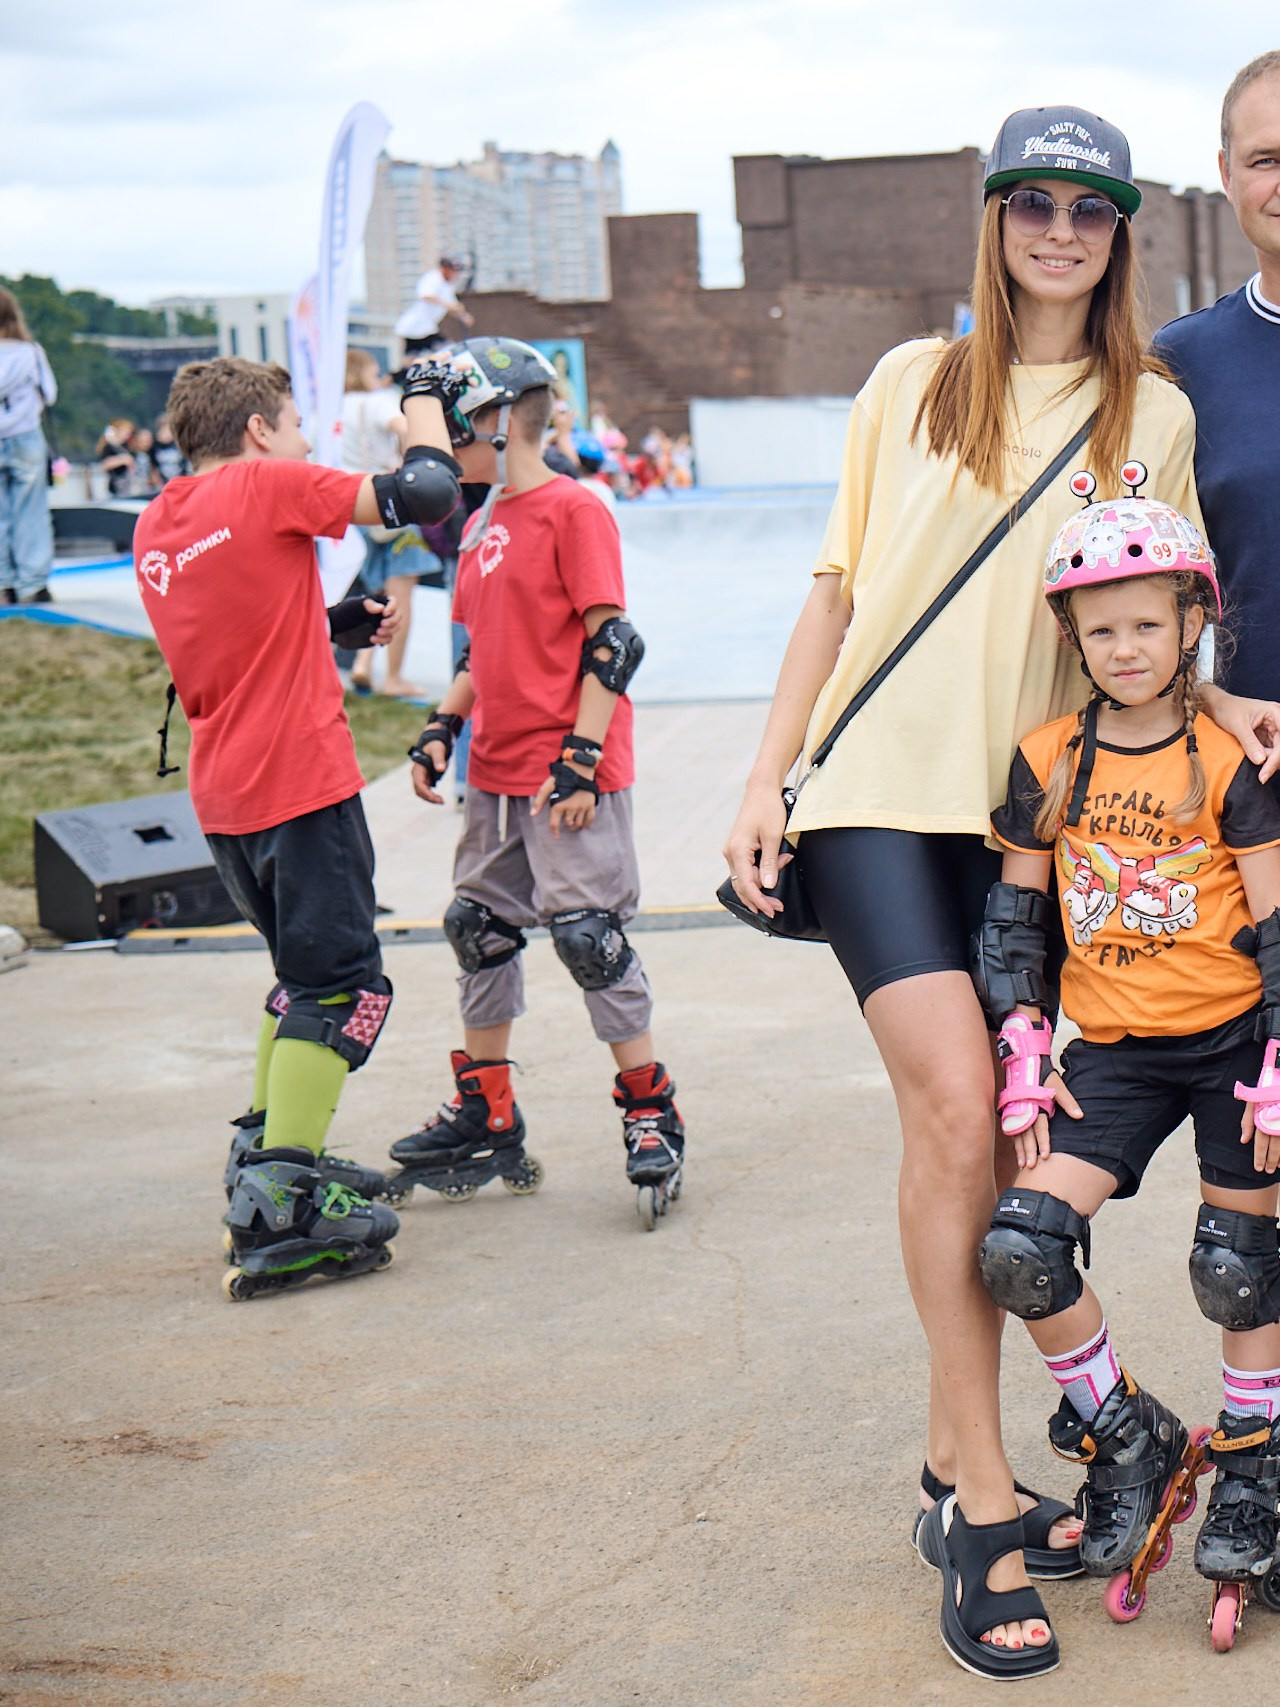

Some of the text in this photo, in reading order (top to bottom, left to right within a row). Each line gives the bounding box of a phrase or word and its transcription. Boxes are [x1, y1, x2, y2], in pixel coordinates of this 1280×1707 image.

[1049, 122, 1091, 141] SALTY FOX
[1021, 136, 1111, 169] Vladivostok
[1055, 157, 1078, 169] SURF
[175, 527, 232, 572] ролики
[1153, 543, 1172, 560] 99
[1081, 790, 1165, 819] СПРАВЬ
